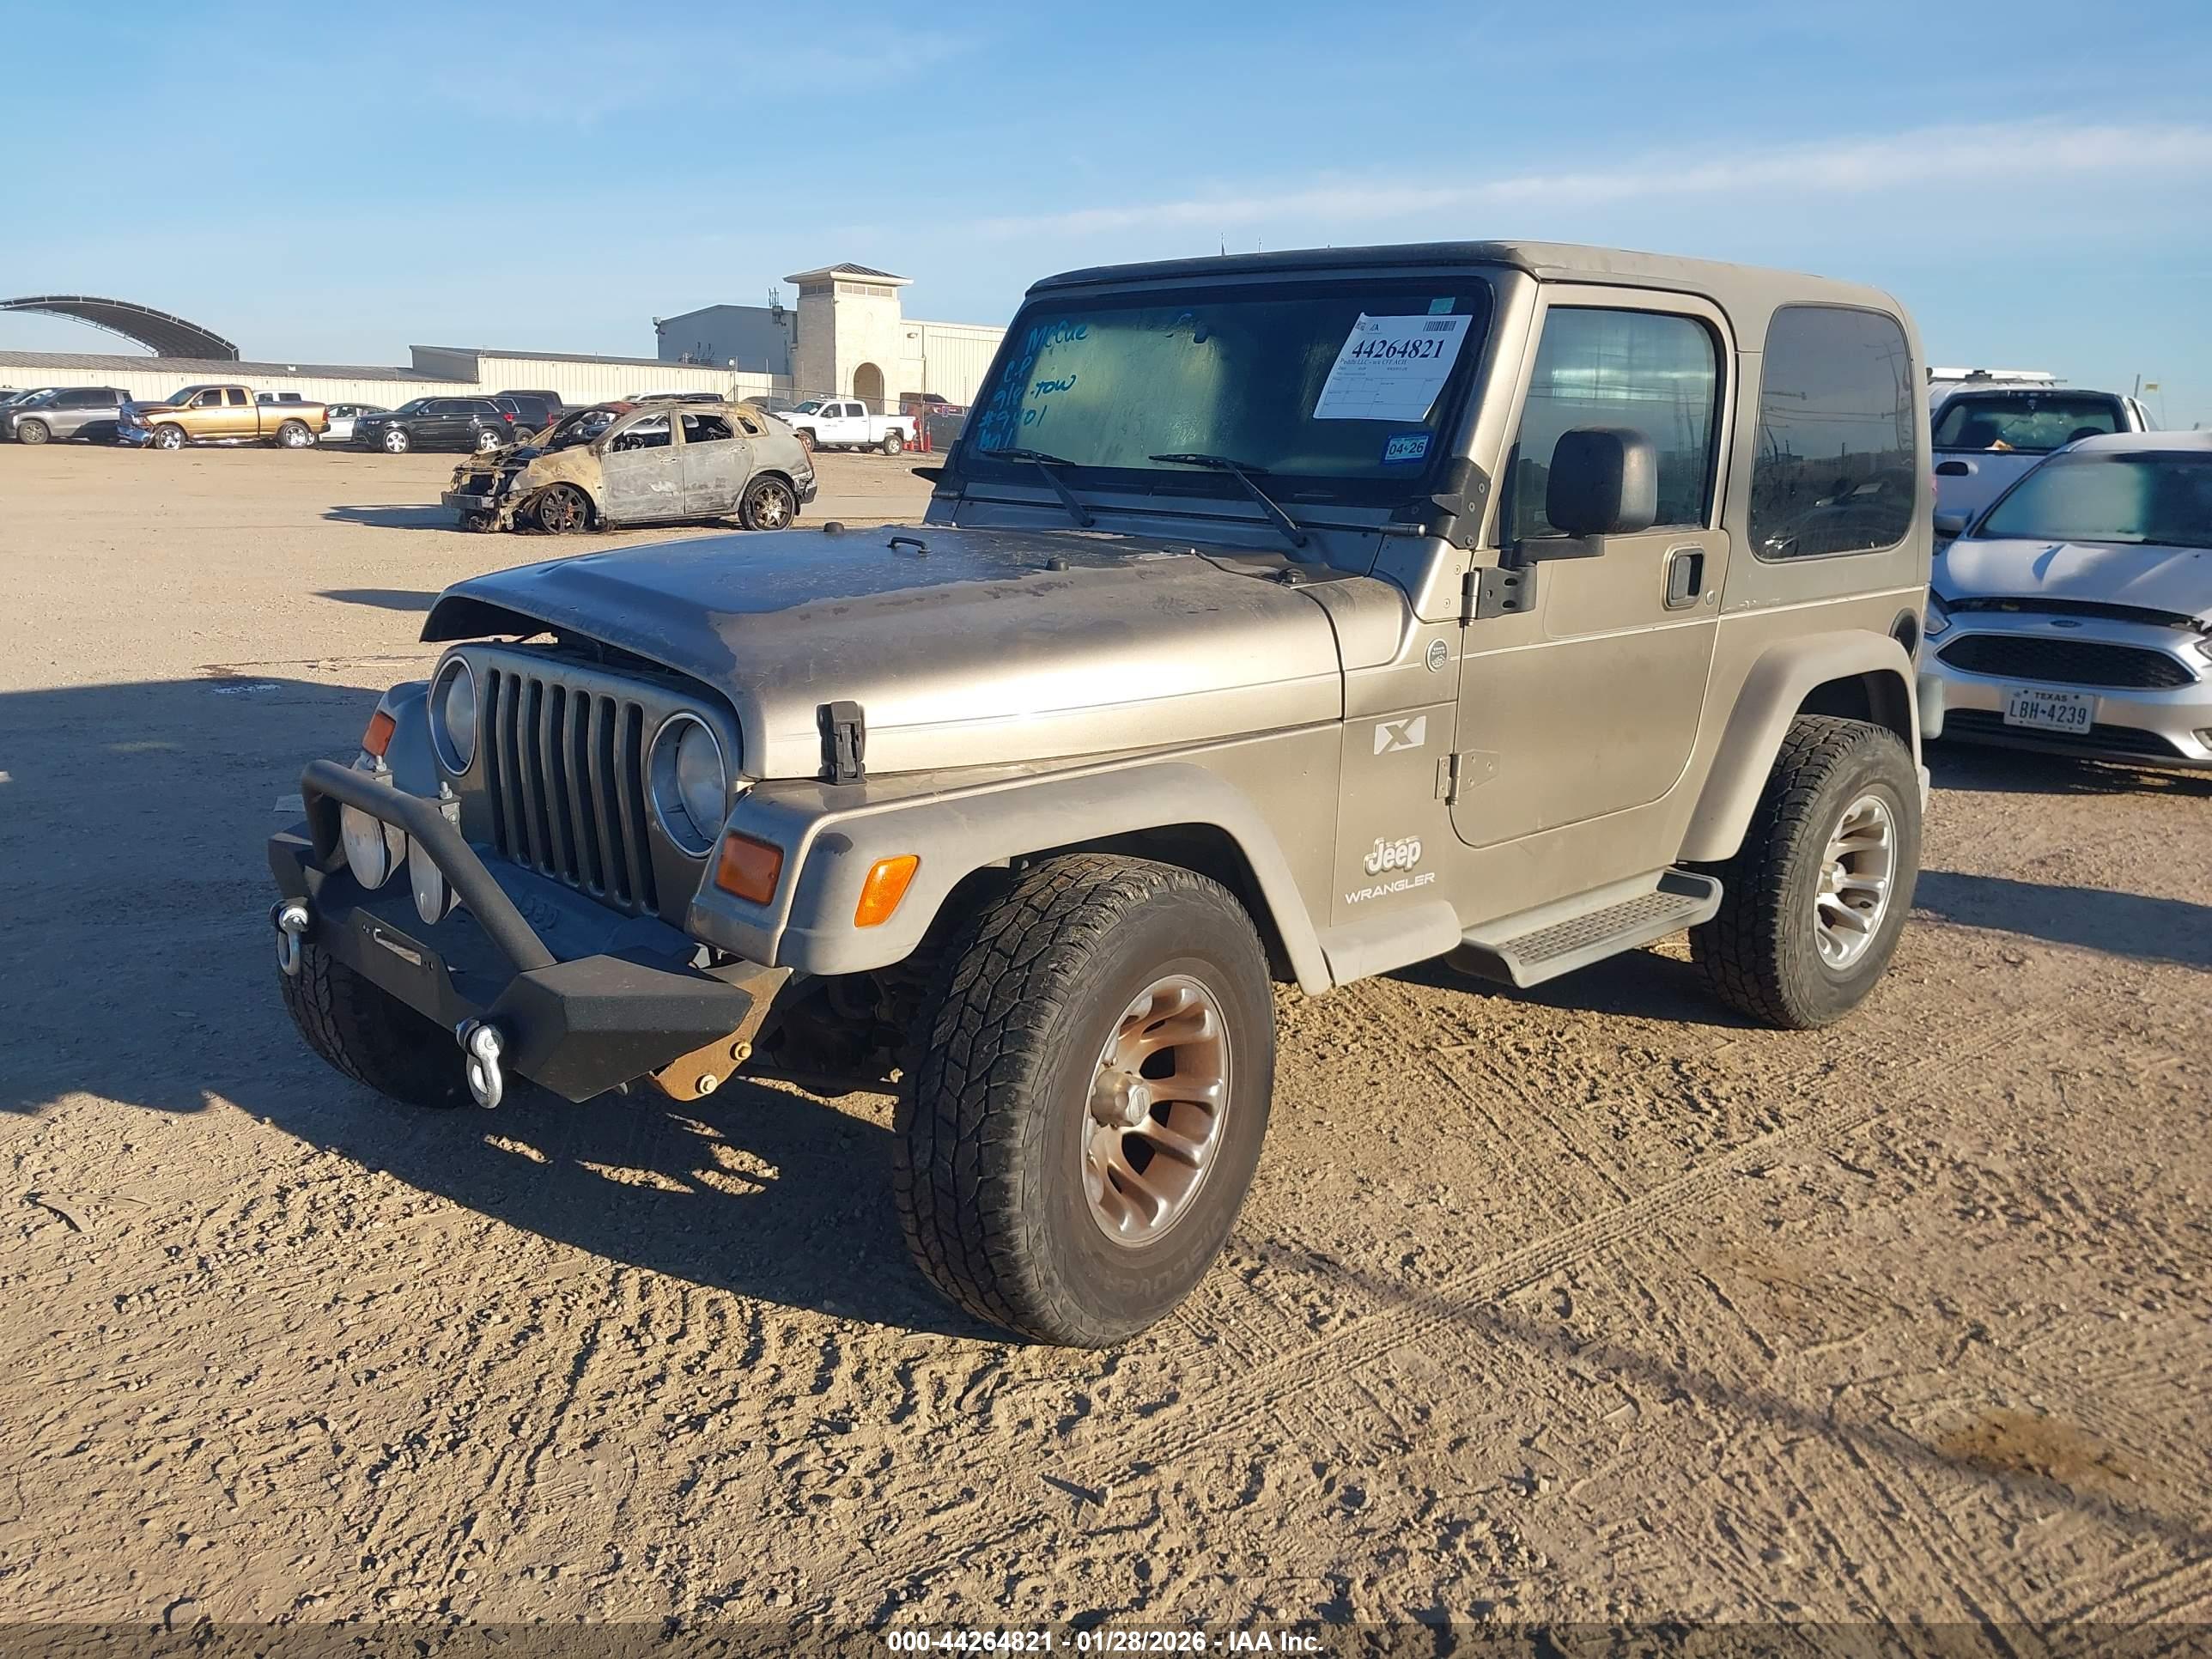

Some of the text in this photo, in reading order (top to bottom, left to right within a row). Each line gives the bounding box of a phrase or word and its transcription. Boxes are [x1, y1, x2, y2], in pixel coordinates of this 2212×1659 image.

[1351, 339, 1445, 359] 44264821
[2034, 692, 2069, 702] TEXAS
[1364, 837, 1422, 876] Jeep
[1345, 872, 1436, 904] WRANGLER
